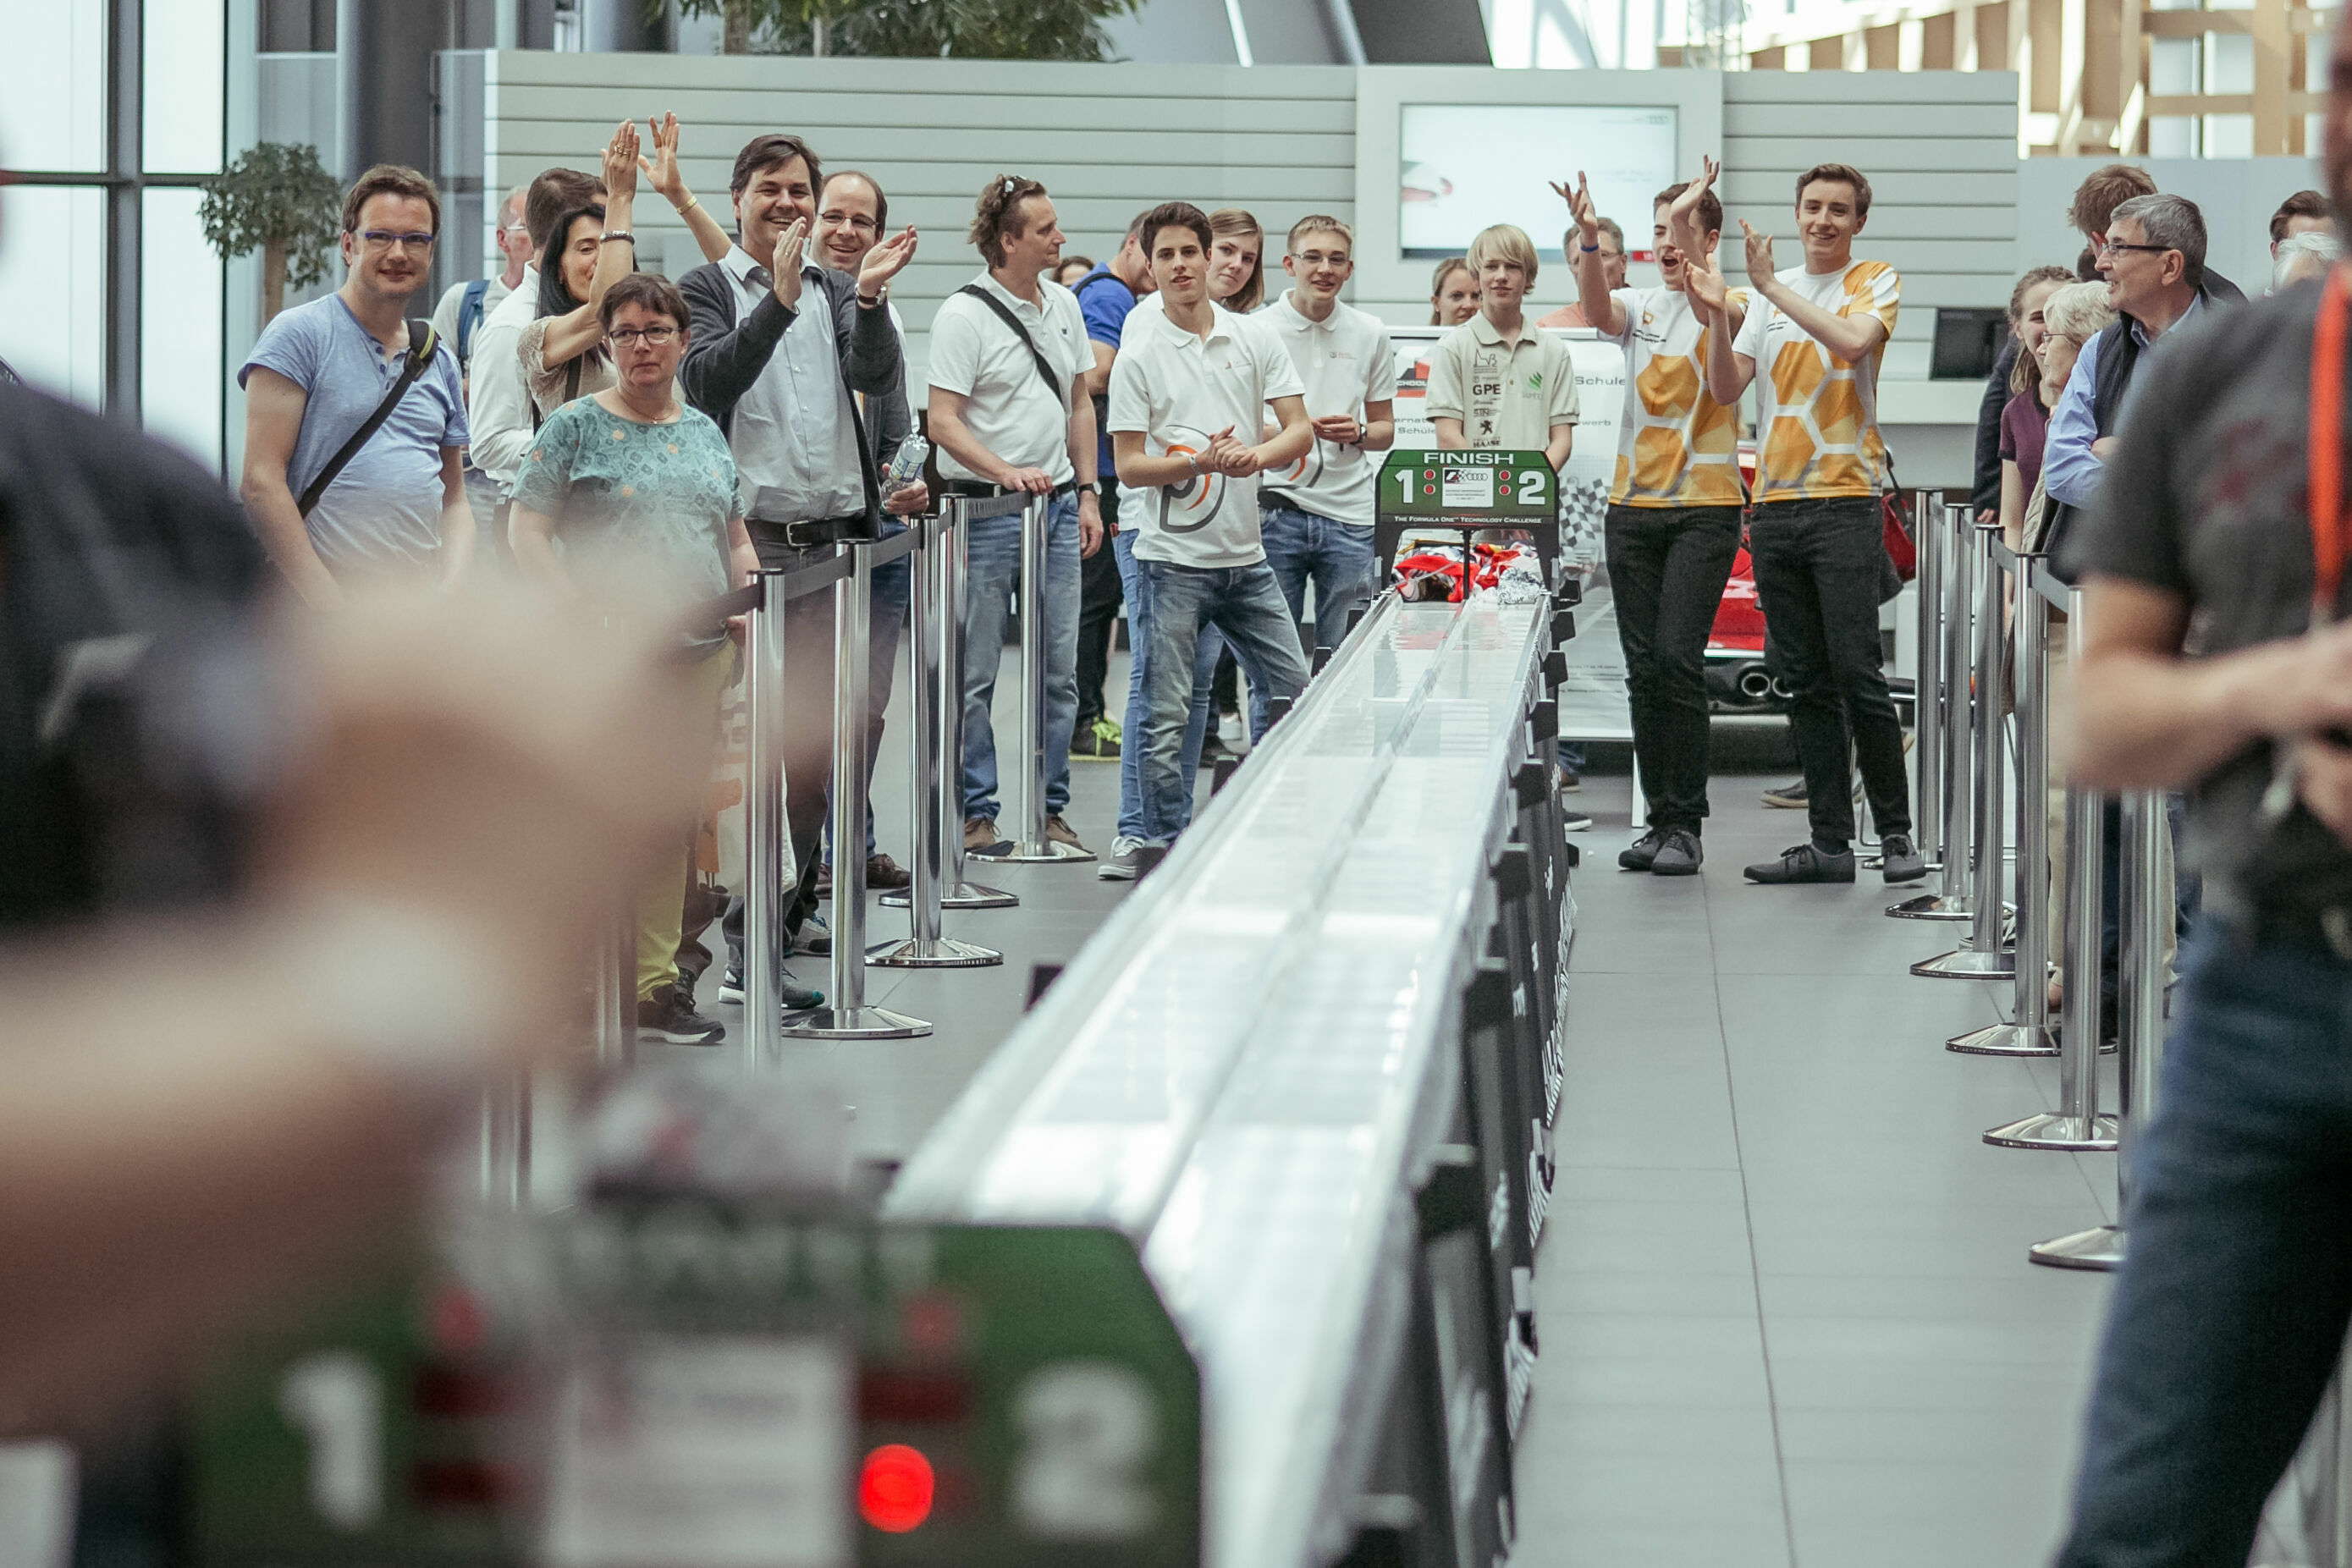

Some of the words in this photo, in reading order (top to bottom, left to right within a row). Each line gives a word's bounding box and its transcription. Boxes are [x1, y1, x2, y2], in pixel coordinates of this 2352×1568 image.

[1473, 383, 1501, 396] GPE
[1424, 452, 1514, 465] FINISH
[1395, 470, 1413, 503] 1
[1518, 470, 1545, 505] 2
[279, 1354, 386, 1526] 1
[1018, 1362, 1156, 1533] 2
